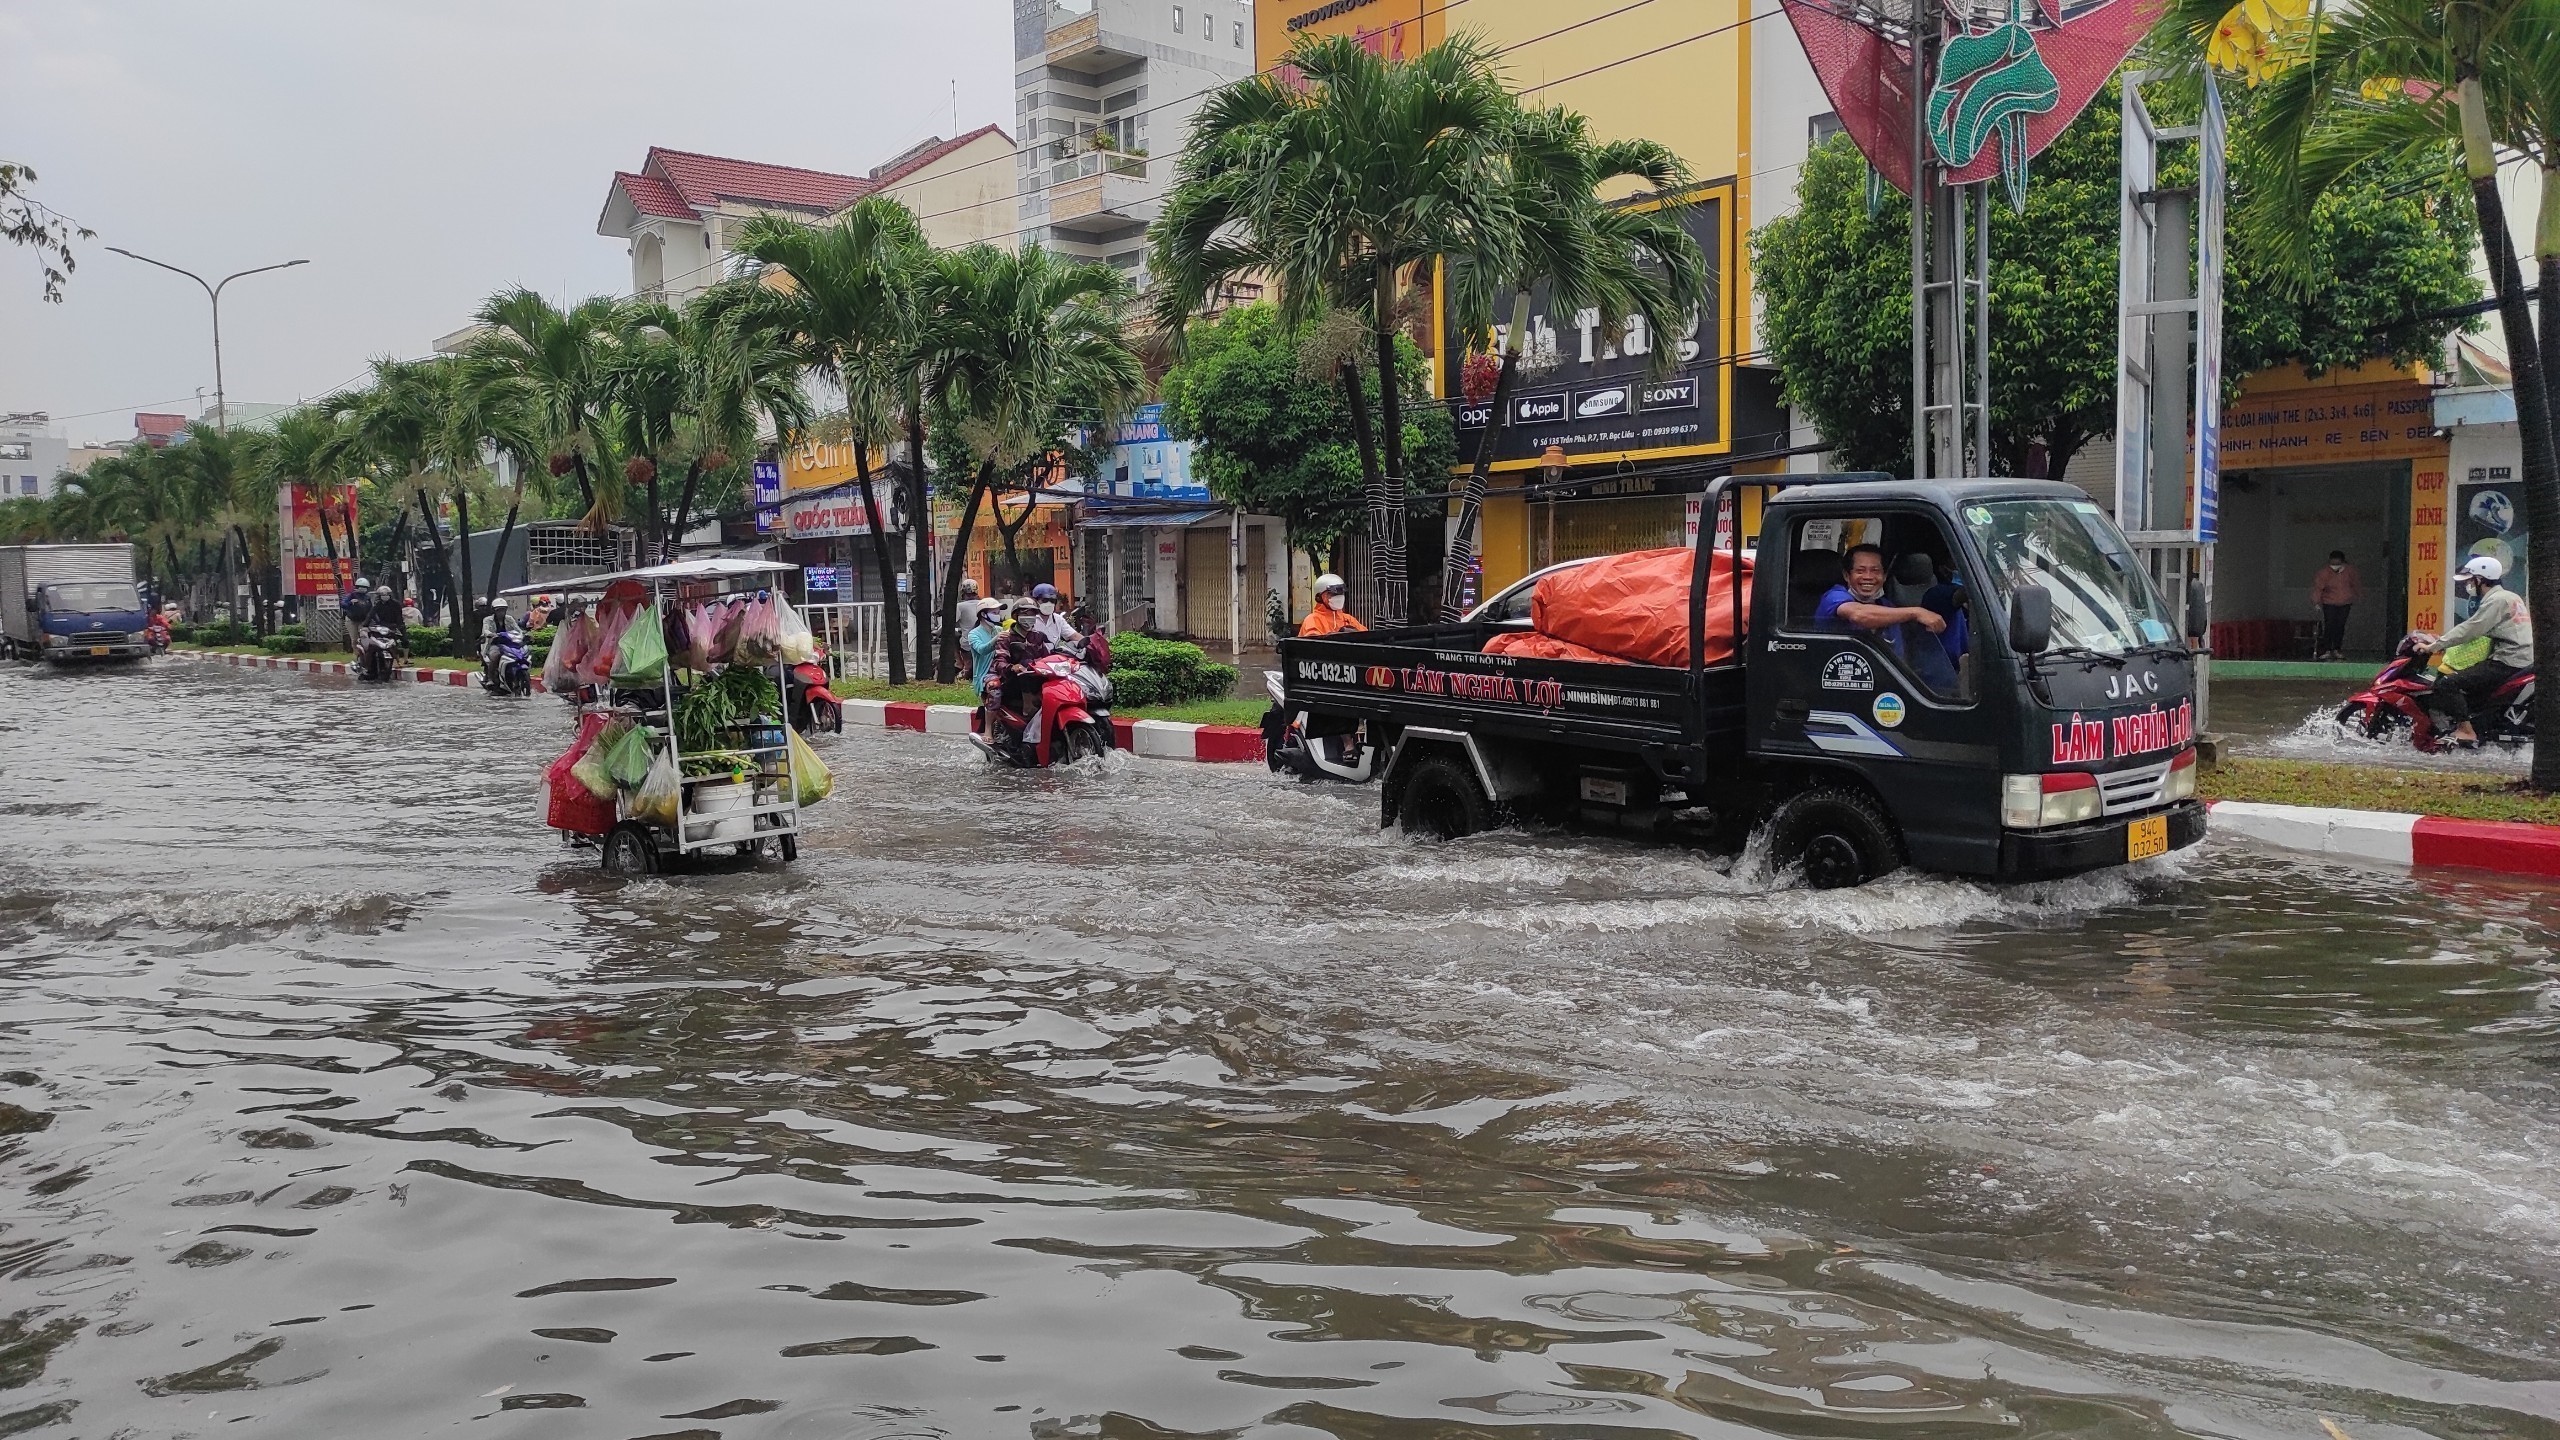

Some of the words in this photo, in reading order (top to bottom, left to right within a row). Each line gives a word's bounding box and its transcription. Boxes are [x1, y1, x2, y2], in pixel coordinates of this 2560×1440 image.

[1584, 396, 1619, 409] SAMSUNG
[1643, 386, 1690, 403] SONY
[1461, 408, 1492, 425] opp
[1532, 402, 1560, 417] Apple
[1670, 426, 1680, 434] 99
[1688, 424, 1698, 432] 79
[2259, 436, 2308, 449] NHANH
[756, 483, 779, 502] Thanh
[2416, 472, 2444, 494] CHỤP
[793, 502, 831, 531] QUỐC
[832, 497, 869, 528] THẮN
[2416, 504, 2442, 526] HÌNH
[1055, 546, 1069, 561] TEL
[2417, 536, 2437, 560] THẺ
[2417, 572, 2438, 596] LẤY
[2416, 606, 2437, 630] GẤP
[1434, 652, 1463, 663] TRANG
[1463, 653, 1478, 664] TRÍ
[1298, 661, 1357, 684] 94C-032.50
[1401, 663, 1448, 697] LÂM
[1450, 669, 1522, 704] NGHĨA
[1523, 676, 1566, 716] LỢI
[2105, 670, 2159, 700] JAC
[2052, 711, 2104, 764] LÂM
[2112, 702, 2169, 758] NGHĨA
[2169, 696, 2193, 751] LỢI
[2140, 820, 2158, 838] 94C
[2133, 836, 2164, 858] 032.50
